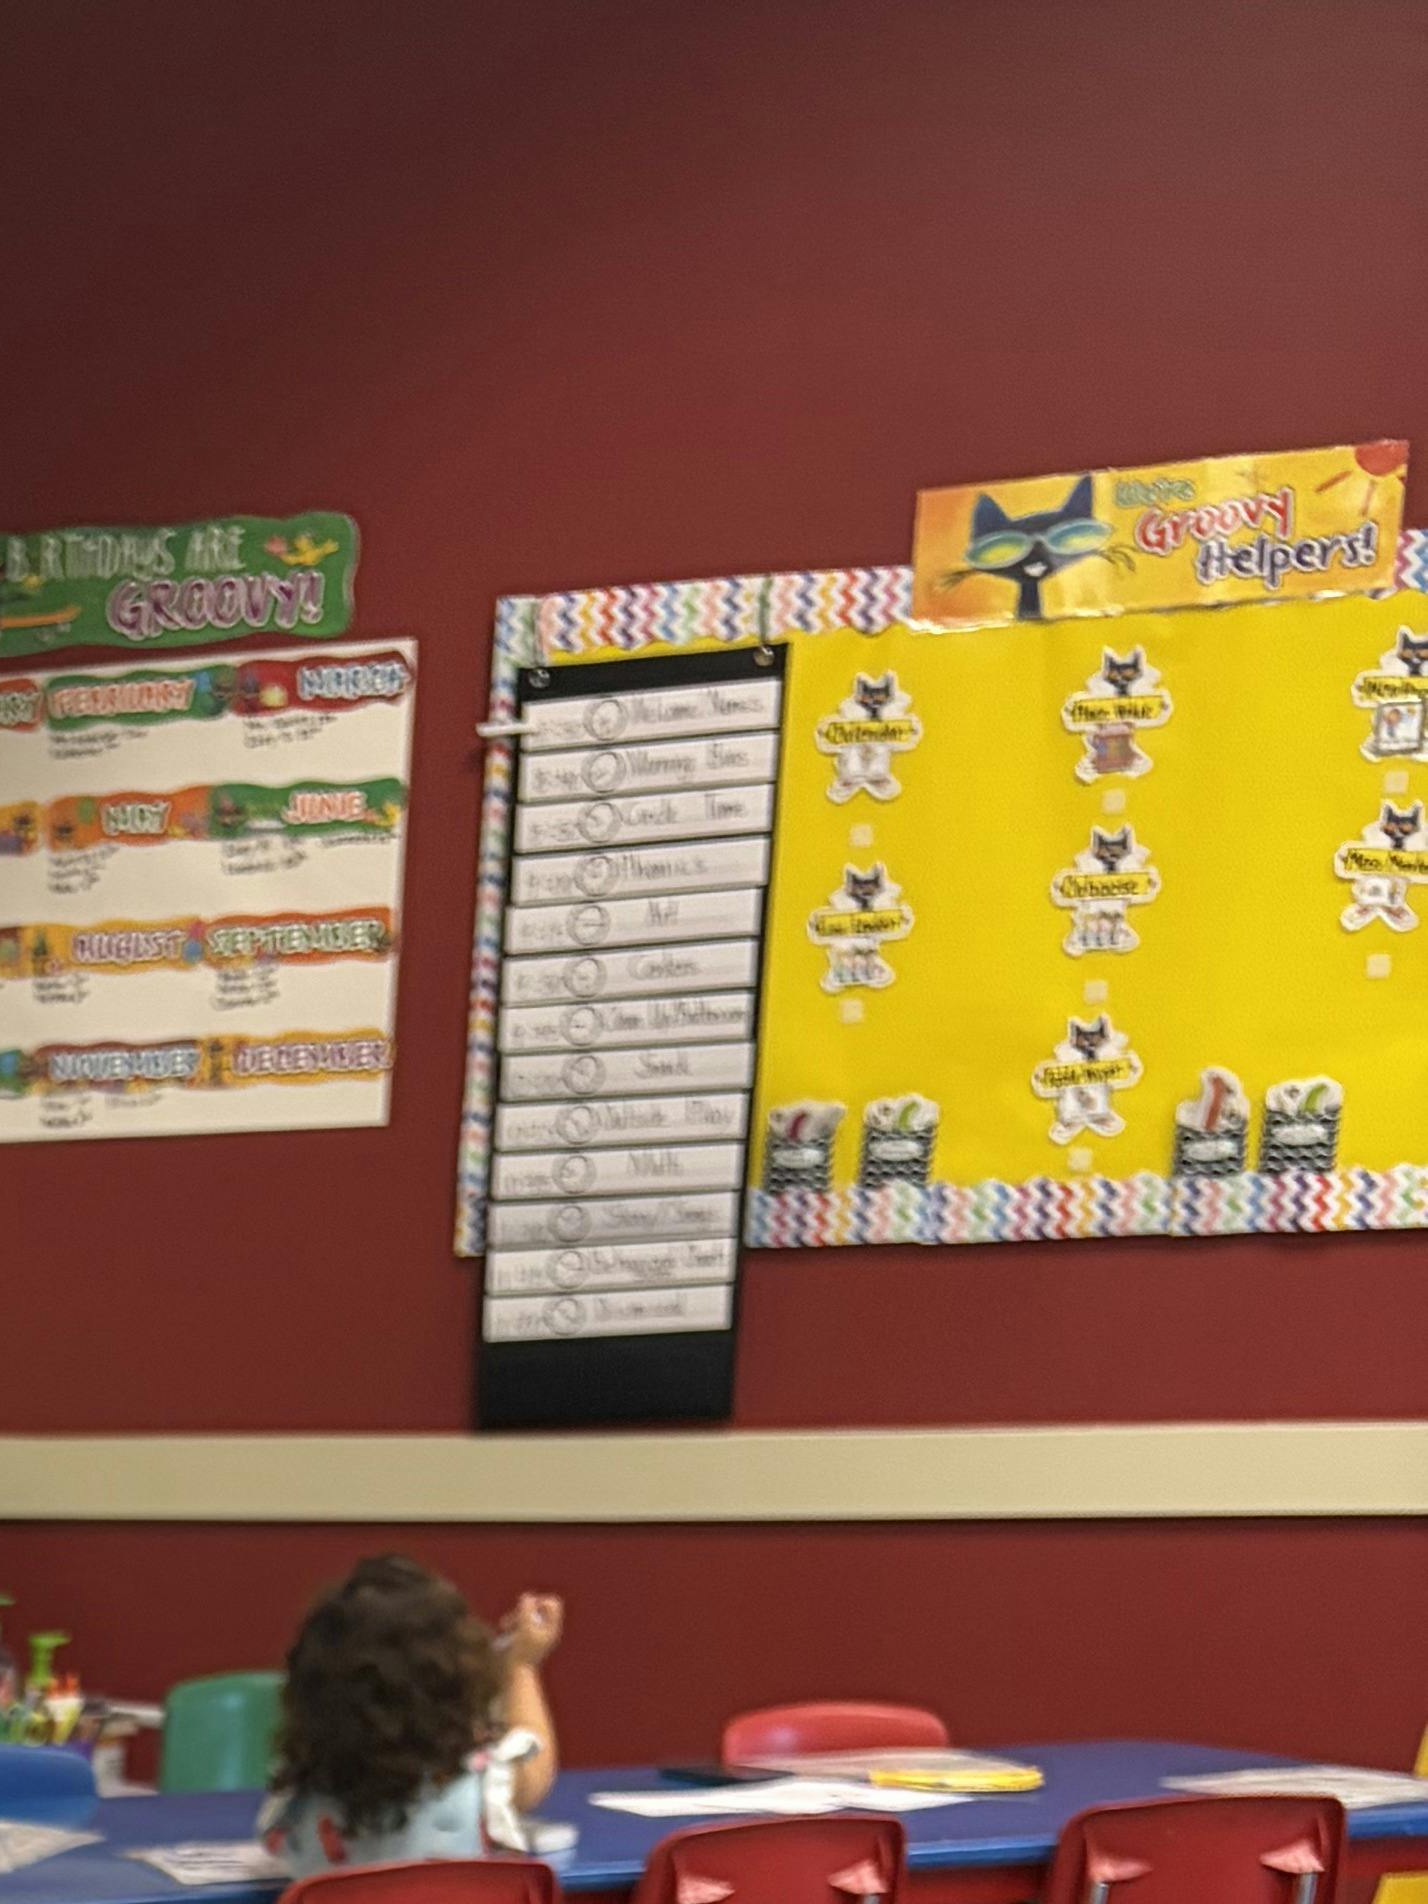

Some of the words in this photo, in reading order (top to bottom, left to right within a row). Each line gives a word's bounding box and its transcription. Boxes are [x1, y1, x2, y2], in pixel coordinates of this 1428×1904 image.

[1135, 487, 1295, 555] Groovy
[1194, 520, 1379, 591] Helpers!
[106, 571, 325, 641] GROOVY!
[100, 801, 172, 836] MAY
[281, 790, 367, 825] JUNE
